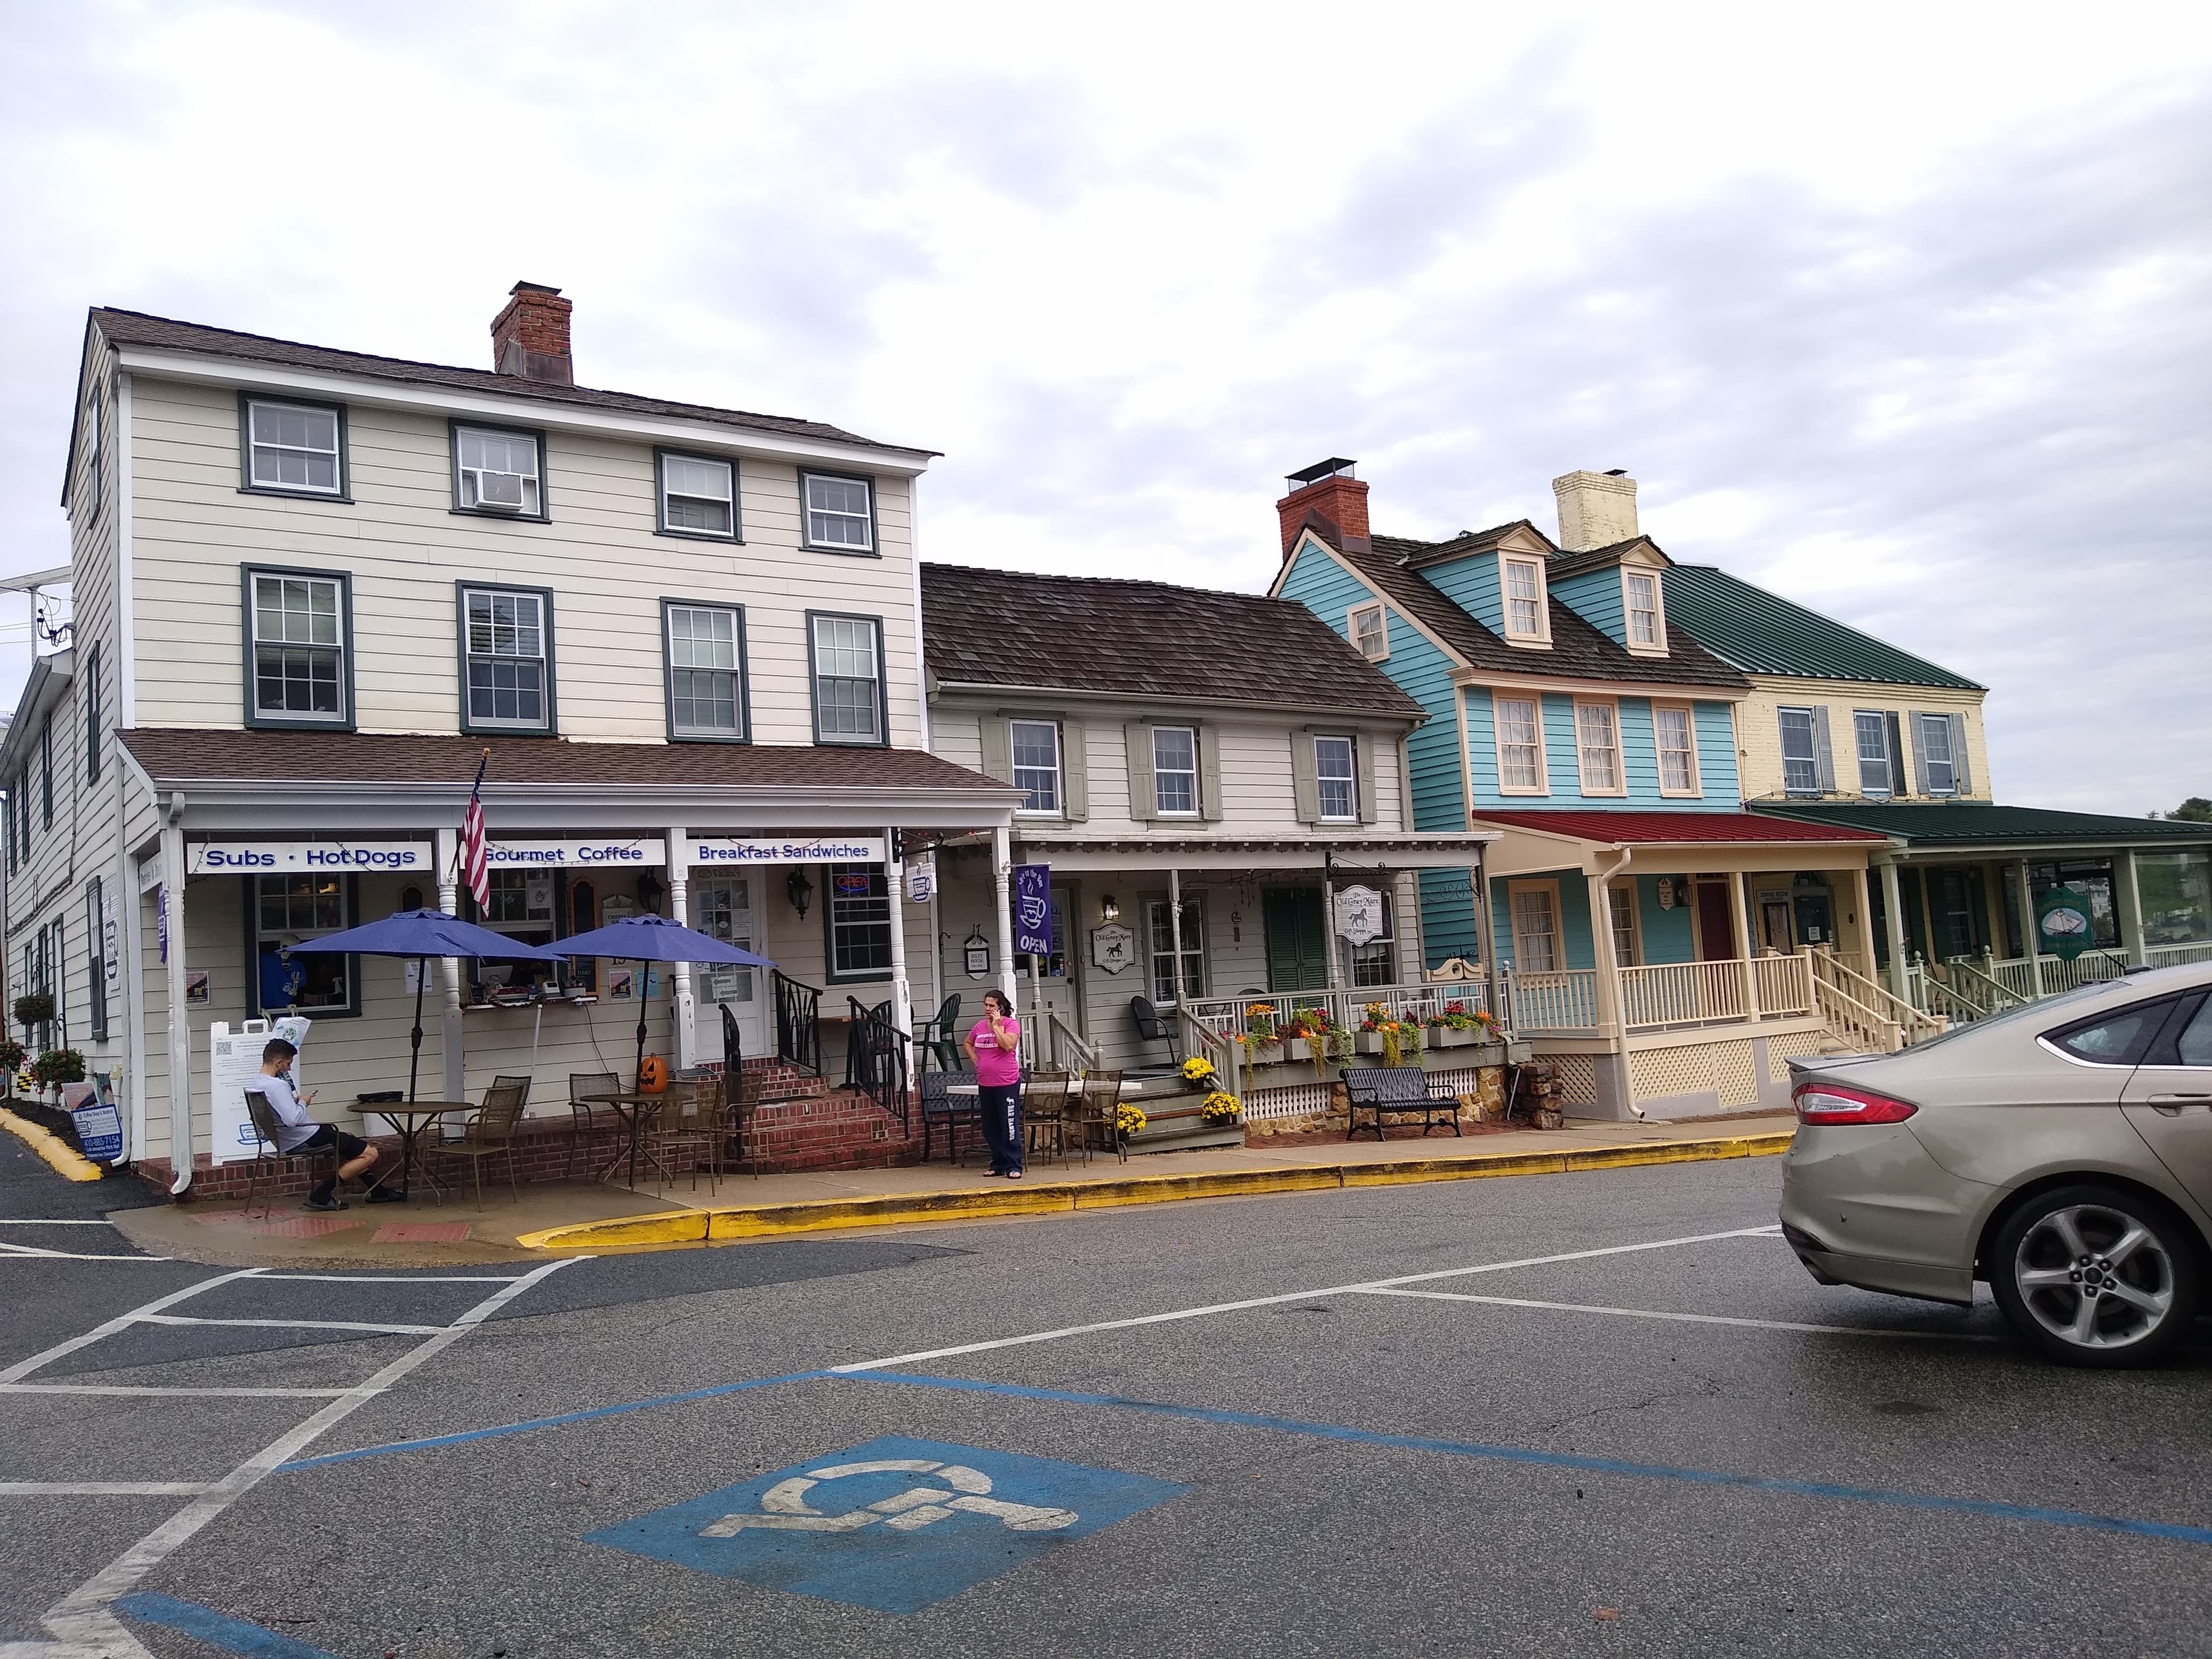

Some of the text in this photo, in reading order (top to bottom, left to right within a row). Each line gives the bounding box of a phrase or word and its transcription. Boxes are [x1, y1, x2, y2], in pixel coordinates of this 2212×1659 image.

[578, 847, 642, 860] Coffee
[699, 844, 869, 859] Breakfast Sandwiches
[206, 850, 276, 866] Subs
[713, 868, 740, 878] Vacancy
[837, 876, 869, 887] OPEN
[1336, 897, 1379, 907] Old Gray Mare
[1020, 935, 1048, 954] OPEN
[1007, 1105, 1015, 1117] BAR
[85, 1135, 120, 1147] 410-885-7154
